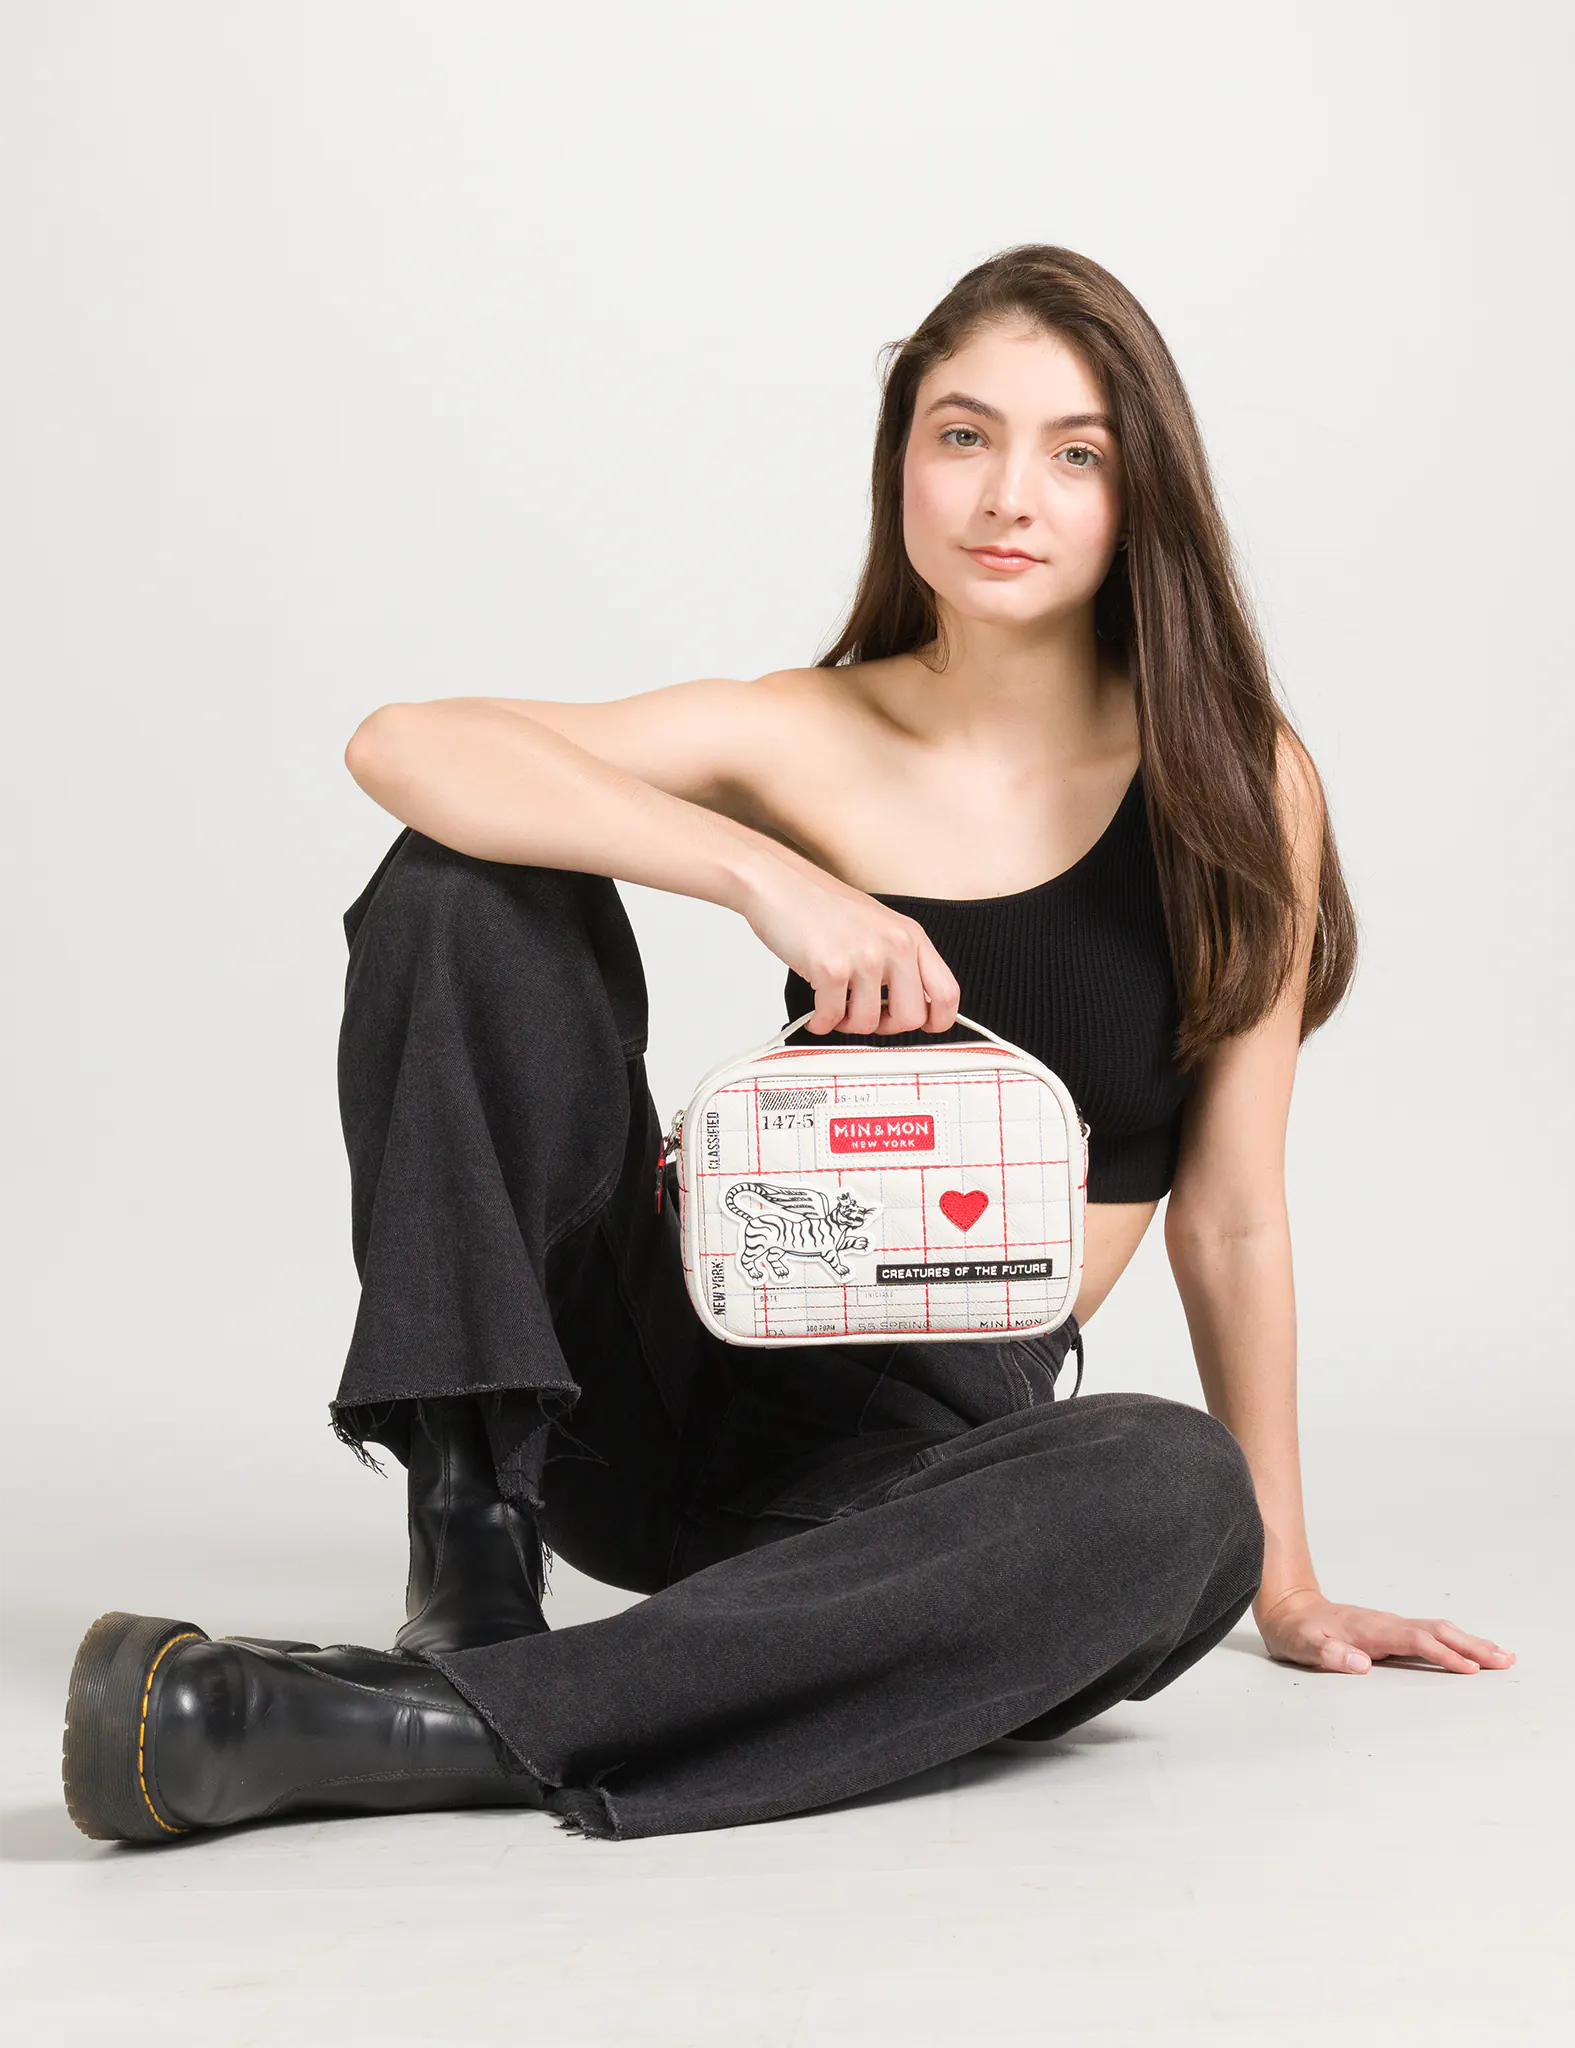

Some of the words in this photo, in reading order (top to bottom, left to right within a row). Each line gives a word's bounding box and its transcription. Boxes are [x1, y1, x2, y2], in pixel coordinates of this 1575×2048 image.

[762, 1113, 814, 1131] 147-5
[833, 1122, 871, 1138] MIN
[874, 1123, 884, 1136] &
[886, 1121, 929, 1137] MON
[706, 1112, 721, 1170] CLASSIFIED
[852, 1140, 877, 1149] NEW
[882, 1139, 916, 1148] YORK
[881, 1266, 951, 1280] CREATURES
[954, 1266, 970, 1277] OF
[974, 1265, 998, 1276] THE
[1002, 1263, 1048, 1275] FUTURE
[713, 1292, 726, 1316] NEW
[880, 1320, 933, 1331] SPRING
[980, 1320, 1004, 1328] MIN
[1015, 1318, 1042, 1327] MON
